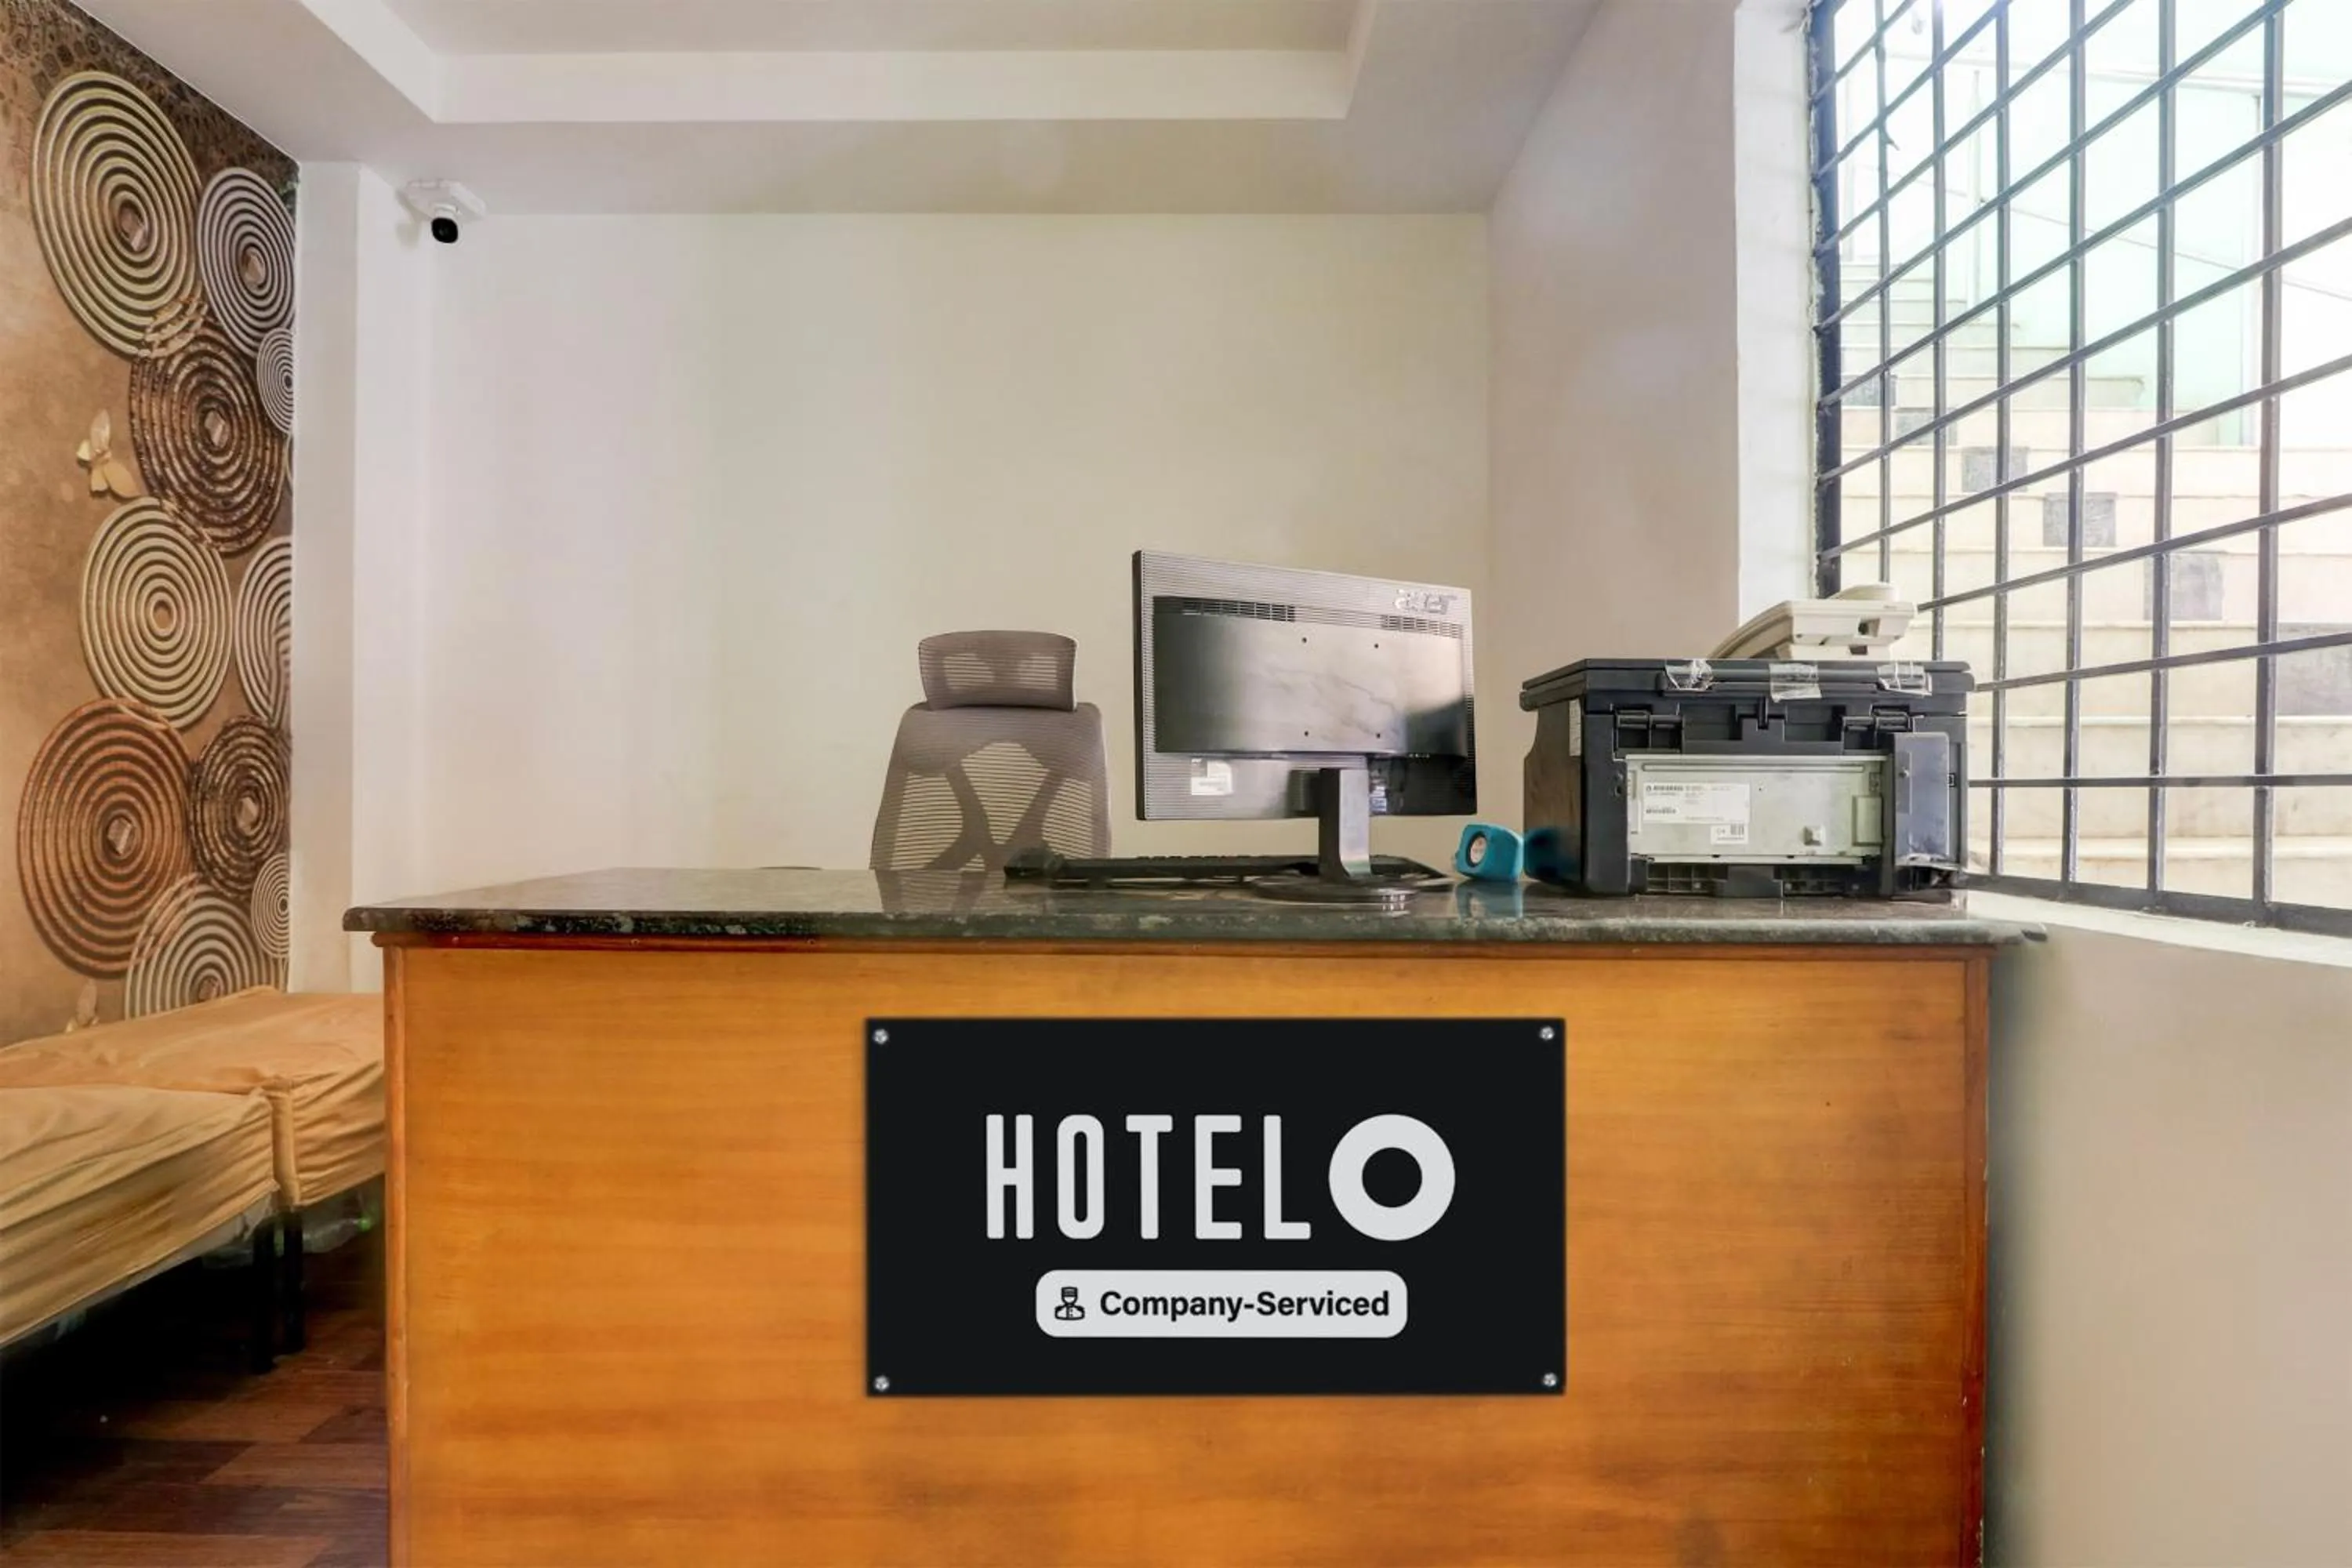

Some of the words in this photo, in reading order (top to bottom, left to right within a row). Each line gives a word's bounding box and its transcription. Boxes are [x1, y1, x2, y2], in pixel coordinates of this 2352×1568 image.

[985, 1114, 1311, 1240] HOTEL
[1328, 1114, 1456, 1241] O
[1099, 1290, 1389, 1323] Company-Serviced
